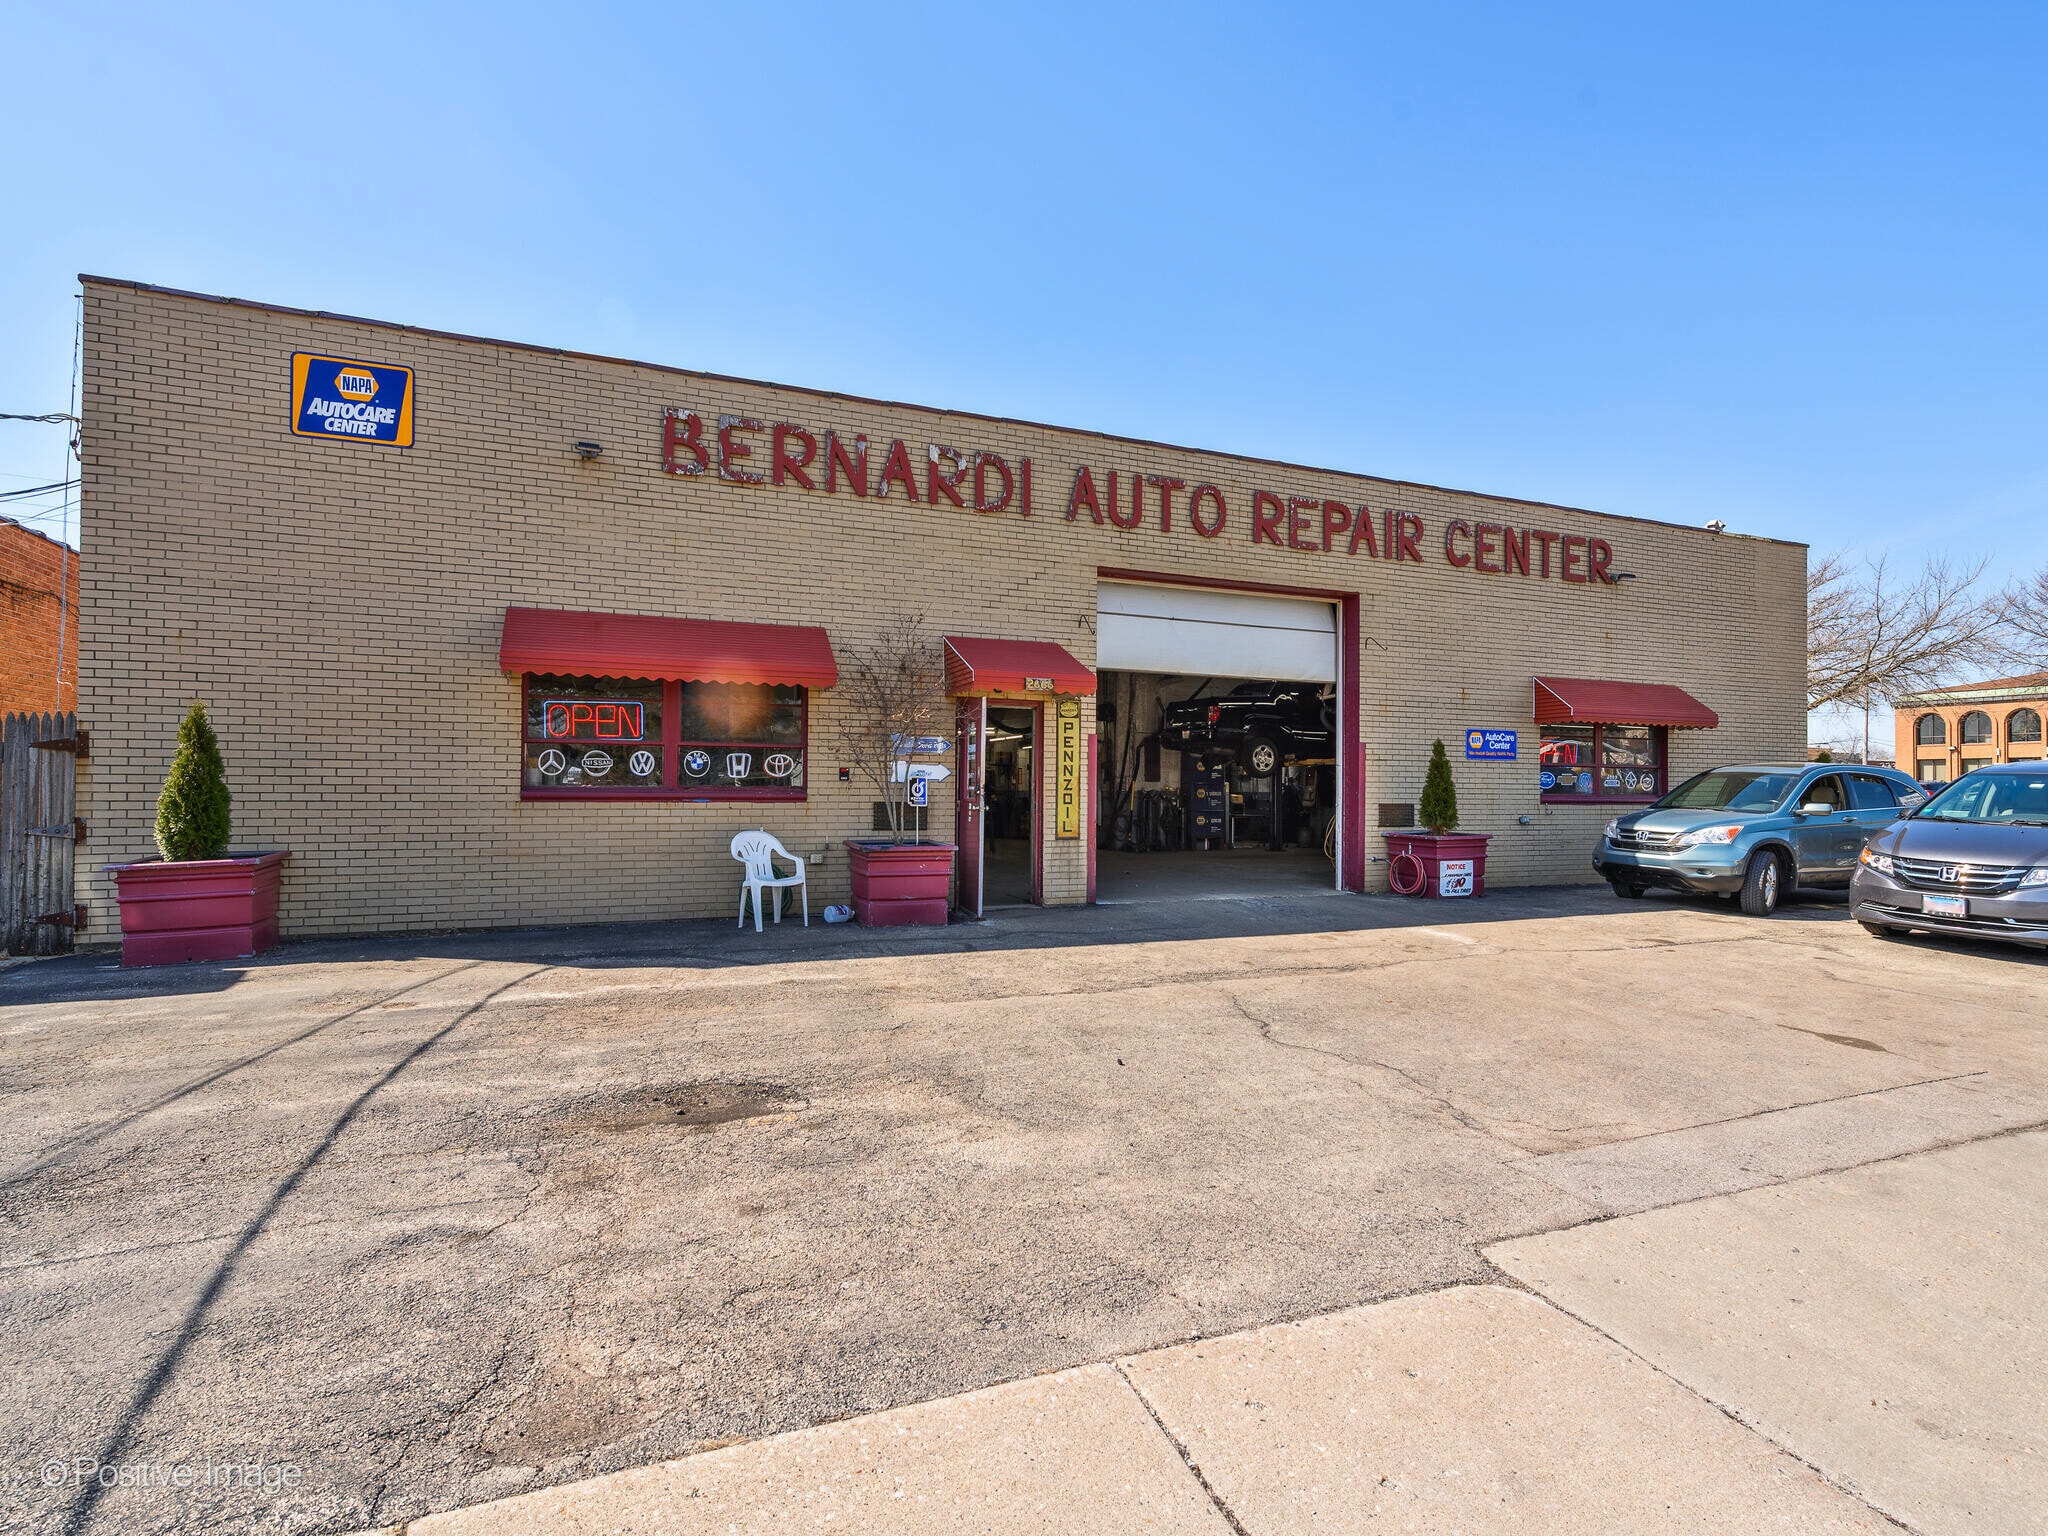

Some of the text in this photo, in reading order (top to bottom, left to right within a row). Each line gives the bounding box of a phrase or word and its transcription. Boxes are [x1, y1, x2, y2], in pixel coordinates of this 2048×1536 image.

[342, 375, 373, 394] NAPA
[324, 418, 378, 436] CENTER
[662, 406, 1616, 584] BERNARDI AUTO REPAIR CENTER
[547, 704, 641, 738] OPEN
[1485, 732, 1515, 742] AutoCare
[1489, 741, 1511, 750] Center
[1063, 721, 1074, 833] PENNZOIL
